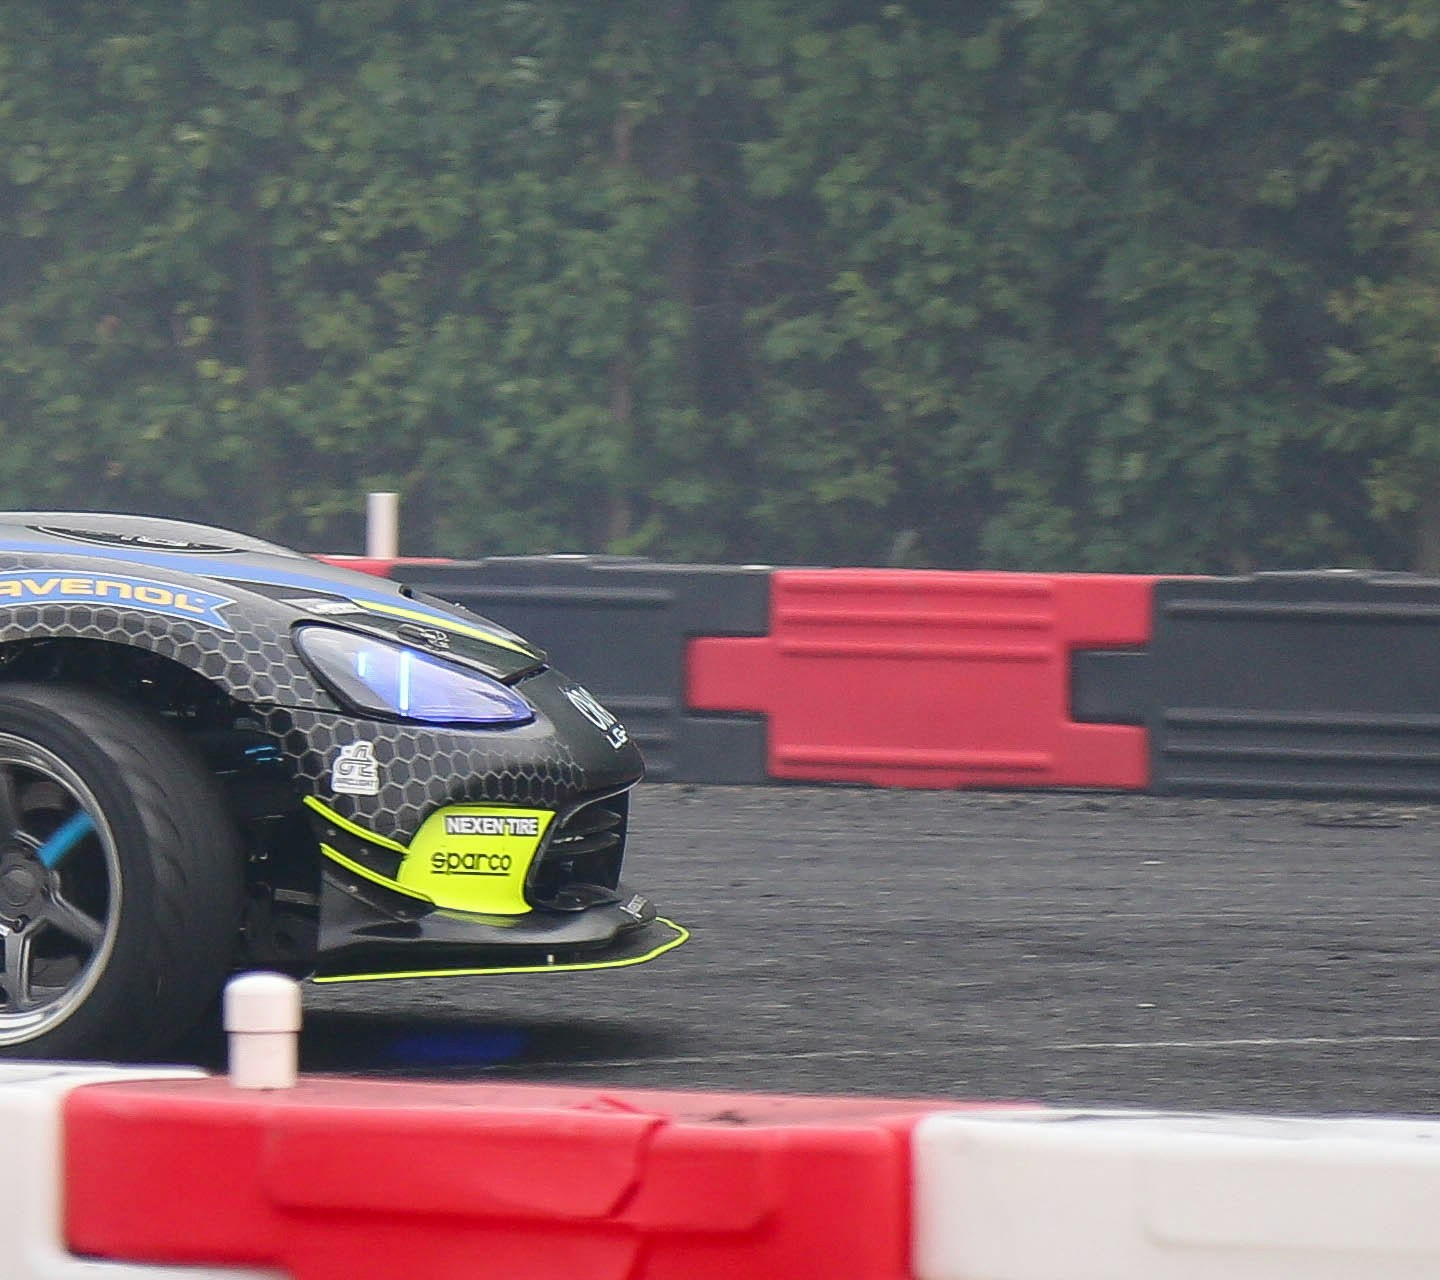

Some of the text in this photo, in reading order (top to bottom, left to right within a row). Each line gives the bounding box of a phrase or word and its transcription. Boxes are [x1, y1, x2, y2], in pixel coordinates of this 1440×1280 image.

[446, 816, 538, 835] NEXEN TIRE
[431, 852, 513, 875] sparco
